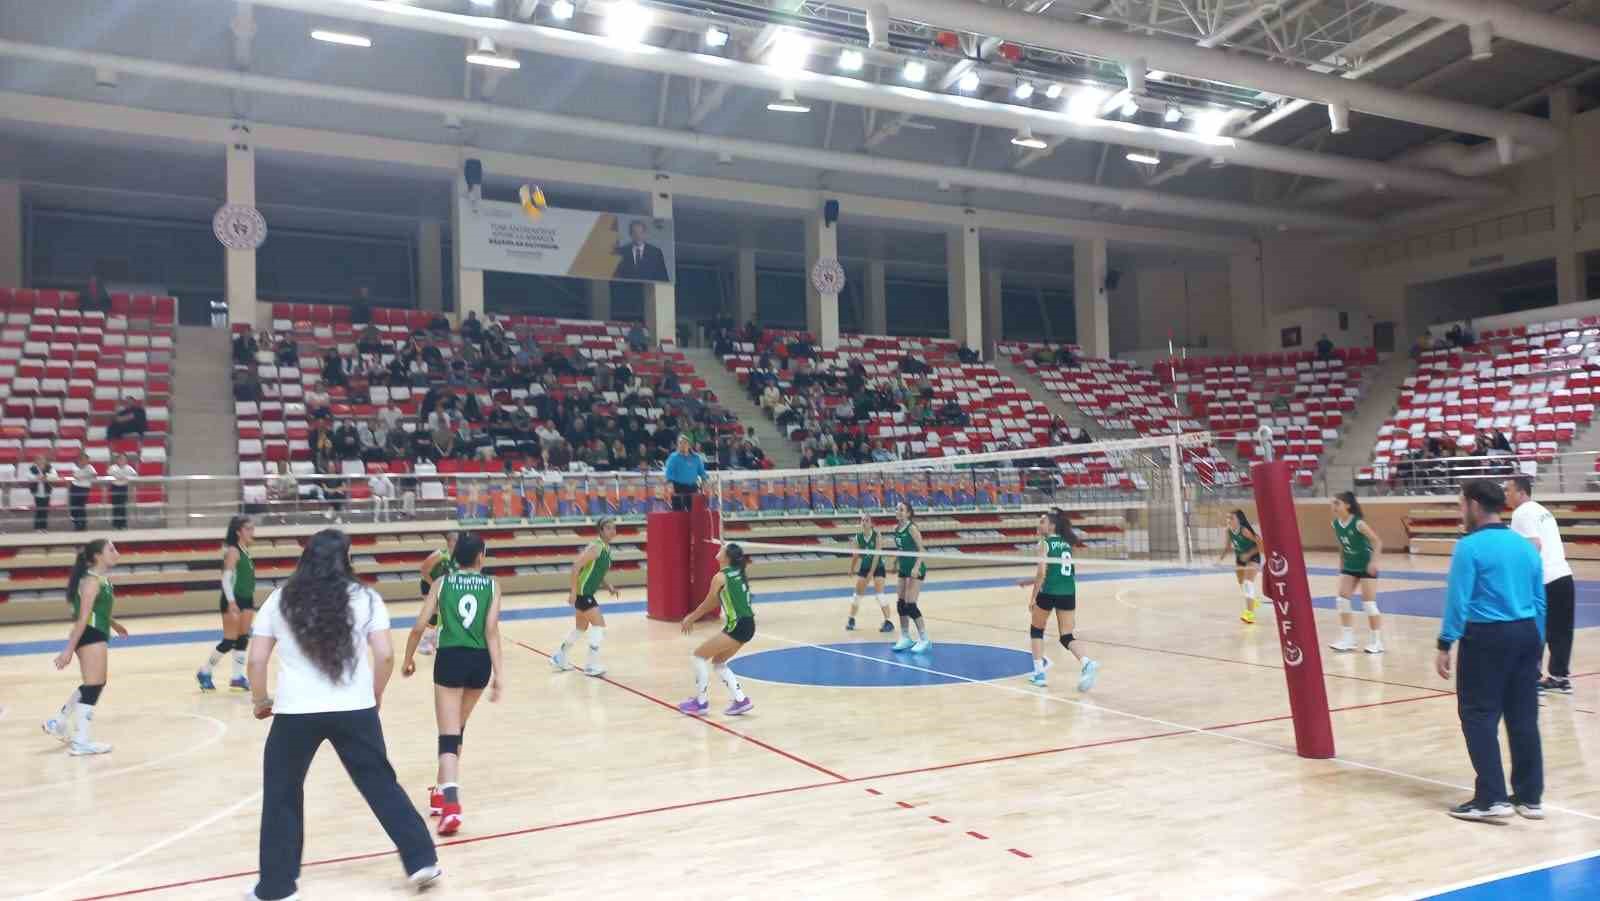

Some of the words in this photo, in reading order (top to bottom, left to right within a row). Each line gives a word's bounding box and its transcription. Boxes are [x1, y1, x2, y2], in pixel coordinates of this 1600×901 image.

[1060, 551, 1072, 576] 8
[458, 593, 478, 629] 9
[1275, 582, 1293, 635] TVF
